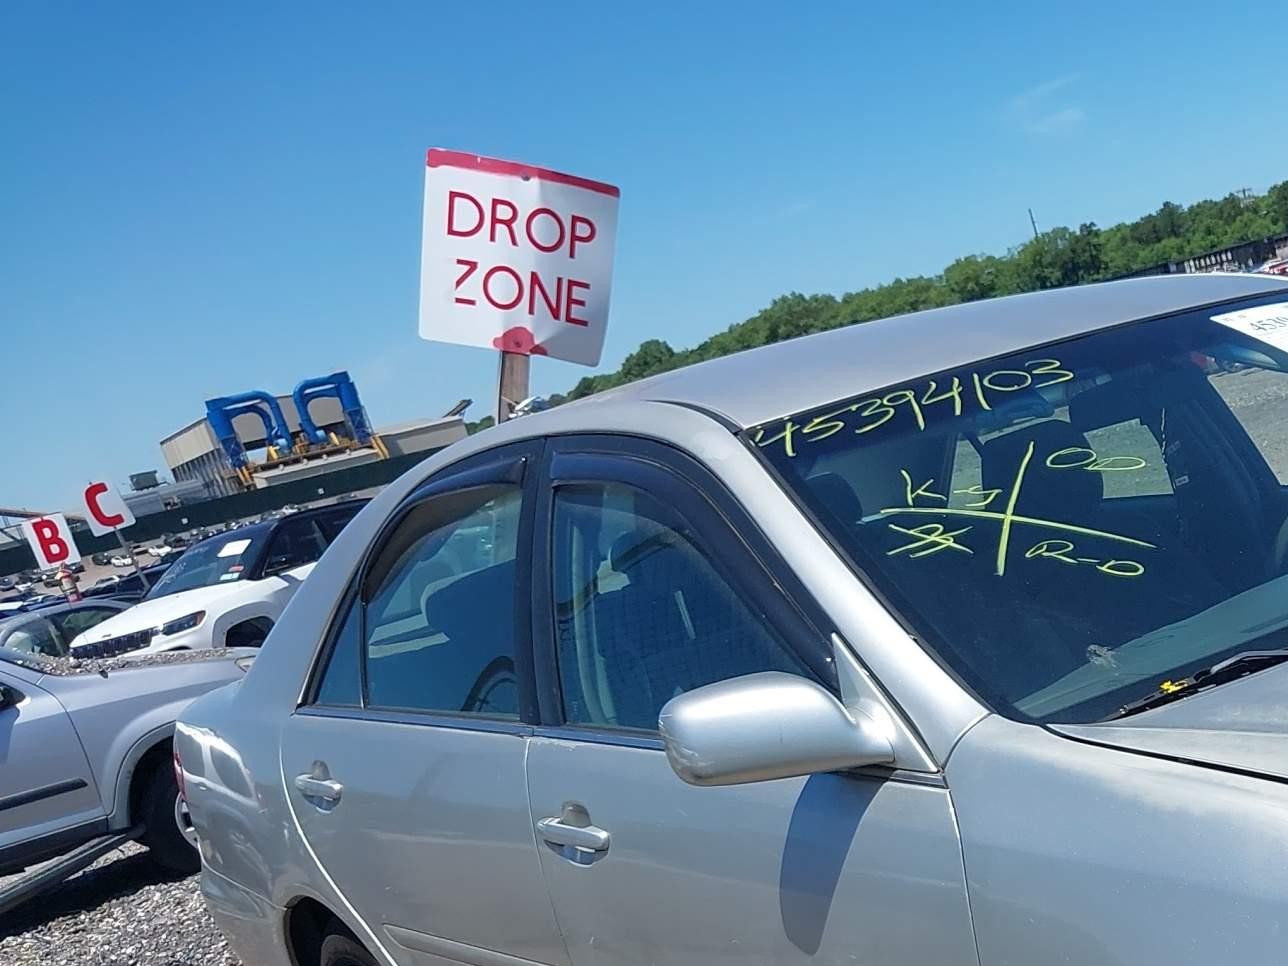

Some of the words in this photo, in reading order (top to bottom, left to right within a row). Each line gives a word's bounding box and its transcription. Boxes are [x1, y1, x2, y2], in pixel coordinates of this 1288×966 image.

[447, 190, 597, 259] DROP
[455, 258, 591, 328] ZONE
[751, 358, 1075, 458] 45394103
[85, 482, 125, 528] C
[32, 519, 69, 565] B
